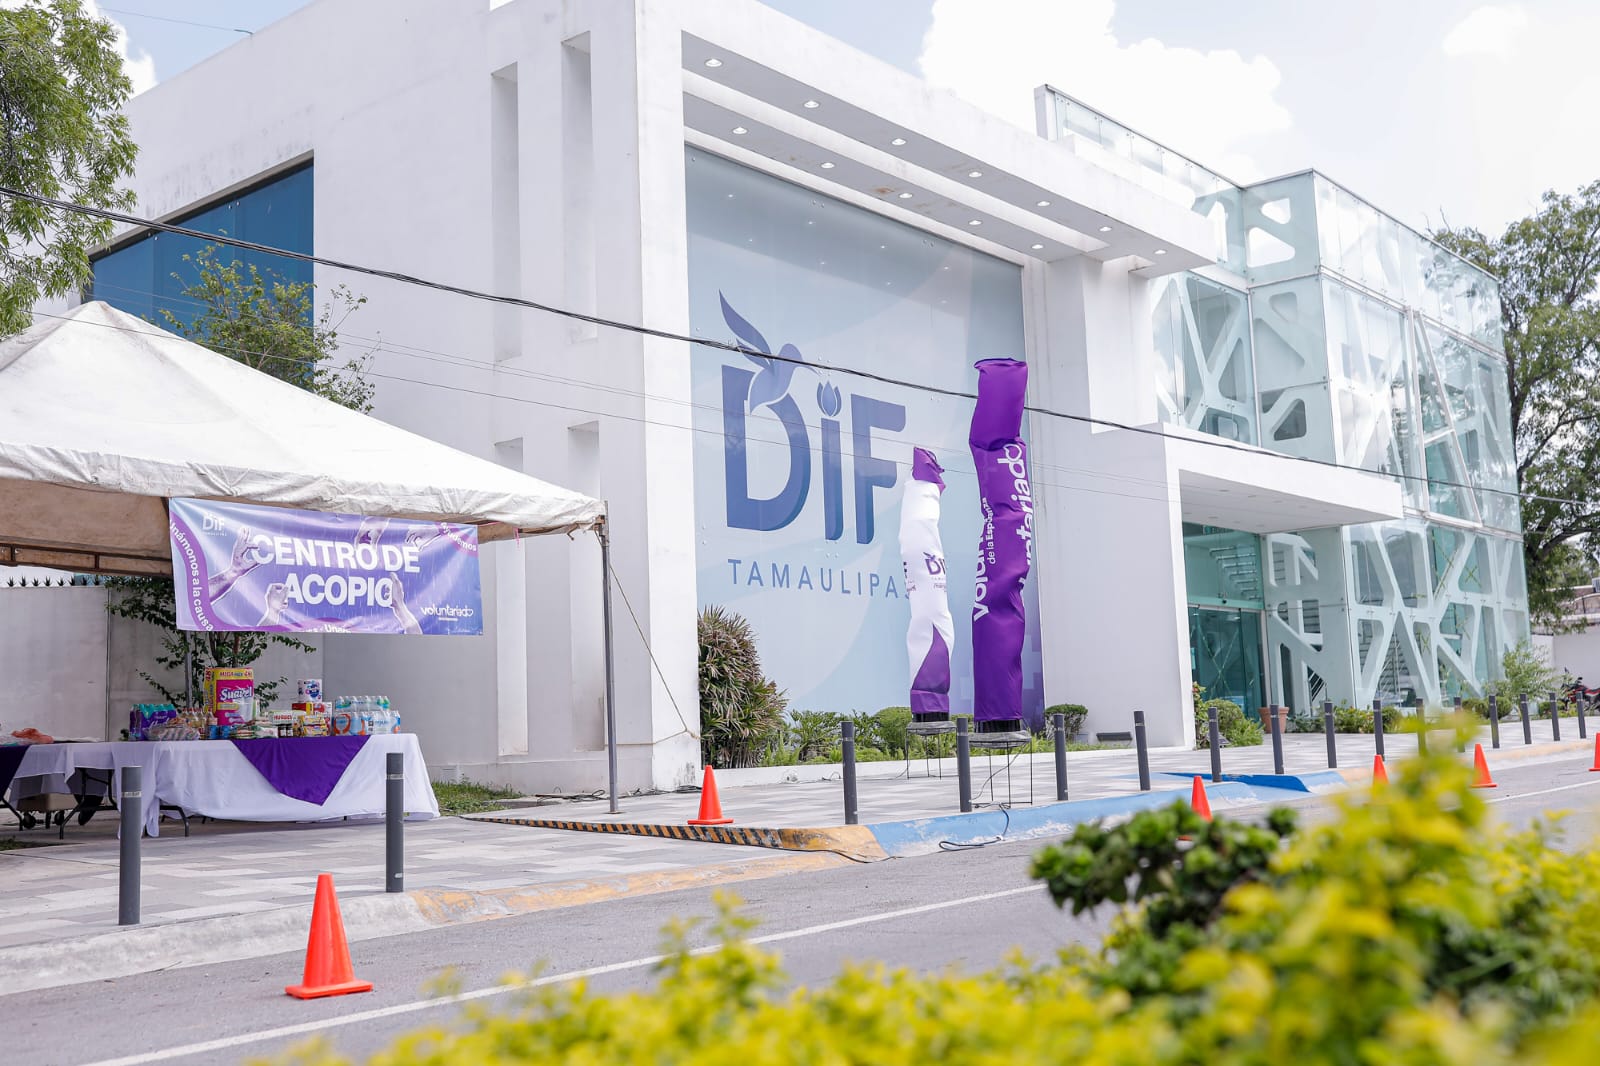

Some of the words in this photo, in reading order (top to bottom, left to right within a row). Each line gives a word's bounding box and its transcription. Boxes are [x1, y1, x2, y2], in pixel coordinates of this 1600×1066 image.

[250, 534, 378, 571] CENTRO
[381, 544, 421, 573] DE
[985, 541, 995, 550] la
[986, 551, 996, 565] de
[192, 586, 203, 598] la
[284, 572, 394, 608] ACOPIO
[727, 558, 910, 600] TAMAULIPA
[193, 600, 214, 632] causa
